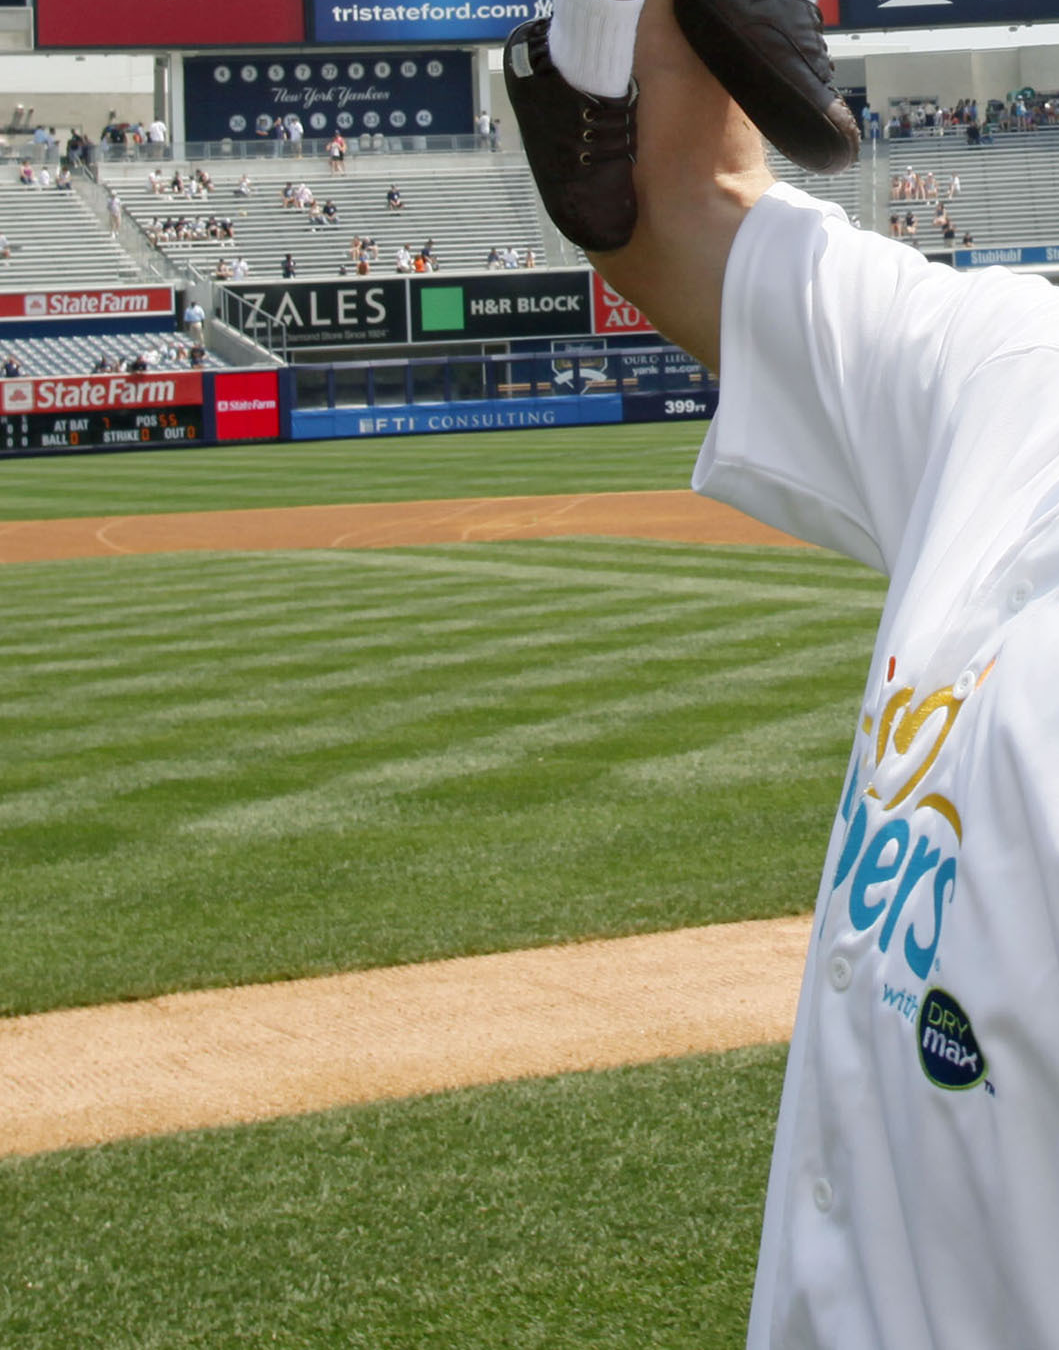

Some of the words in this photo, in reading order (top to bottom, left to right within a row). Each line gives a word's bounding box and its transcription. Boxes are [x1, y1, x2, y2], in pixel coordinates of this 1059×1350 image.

[332, 3, 528, 22] tristateford.com
[270, 86, 301, 103] New
[303, 86, 336, 110] York
[337, 85, 391, 109] Yankees
[970, 249, 1022, 265] StubHub!
[243, 288, 387, 329] ZALES
[470, 298, 511, 316] H&R
[517, 294, 581, 314] BLOCK
[37, 381, 106, 409] State
[108, 378, 175, 403] Farm
[54, 420, 67, 433] AT
[69, 418, 89, 431] BAT
[136, 414, 158, 427] POS
[376, 418, 415, 432] FTI
[428, 410, 556, 430] CONSULTING
[42, 433, 68, 446] BALL
[103, 429, 140, 443] STRIKE
[164, 427, 186, 439] OUT
[882, 983, 919, 1024] with
[927, 1001, 969, 1040] DRY
[922, 1026, 978, 1073] max
